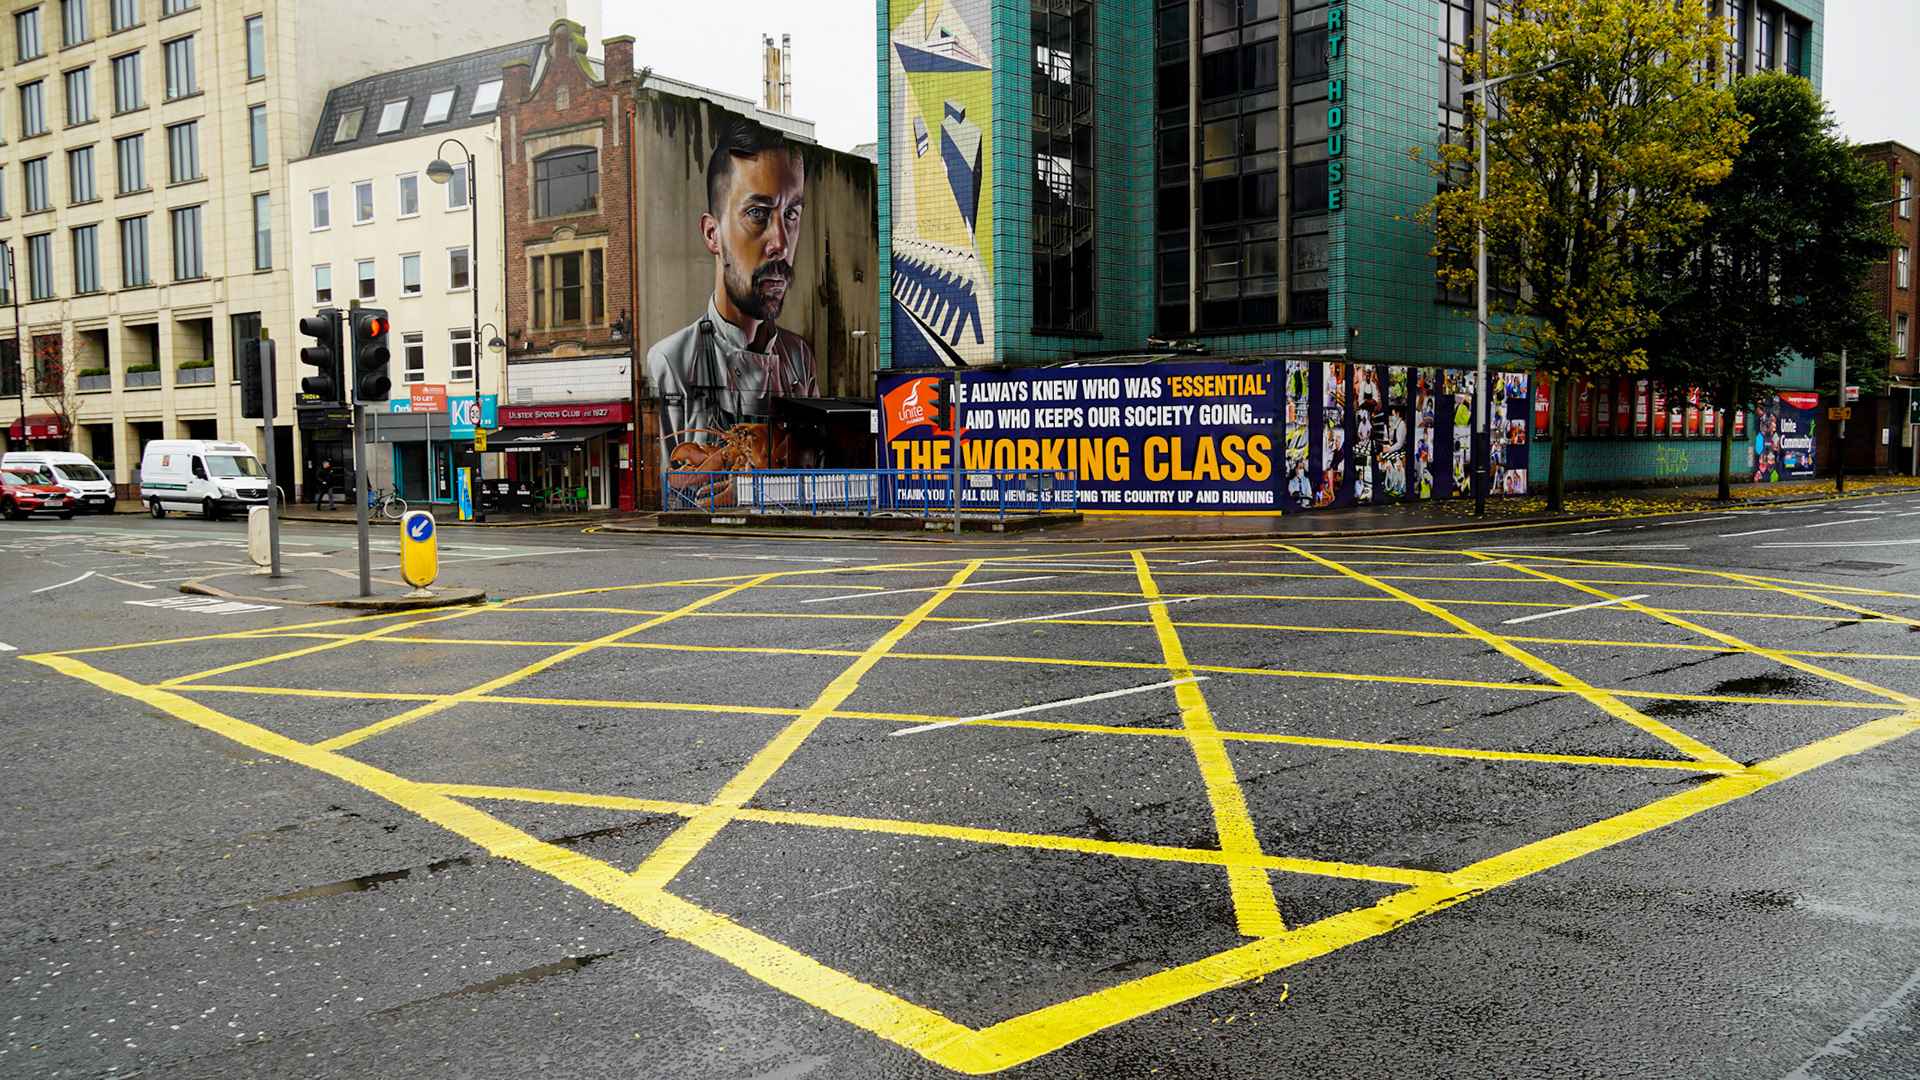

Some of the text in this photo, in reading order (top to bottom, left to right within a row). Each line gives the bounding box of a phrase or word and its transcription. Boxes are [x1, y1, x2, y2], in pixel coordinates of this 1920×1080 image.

[1328, 0, 1342, 210] RT HOUSE
[971, 381, 1028, 403] ALWAYS
[1032, 380, 1078, 401] KNEW
[1082, 378, 1120, 400] WHO
[1124, 377, 1162, 399] WAS
[1167, 374, 1271, 398] 'ESSENTIAL'
[471, 409, 479, 419] 30
[508, 411, 533, 419] ULSTER
[561, 409, 581, 418] CLUB
[592, 409, 609, 417] 1927
[965, 404, 1273, 429] AND WHO KEEPS OUR SOCIETY GOING...
[1780, 419, 1797, 433] Unite
[1780, 434, 1813, 453] Community
[891, 435, 1272, 482] THE WORKING CLASS
[897, 489, 925, 501] THANK
[927, 489, 945, 501] YOU
[963, 489, 978, 501] ALL
[980, 489, 999, 501] OUR
[1055, 489, 1098, 502] KEEPING
[1101, 490, 1121, 503] THE
[1124, 490, 1175, 503] COUNTRY
[1178, 490, 1193, 503] UP
[1196, 490, 1220, 503] AND
[1223, 490, 1274, 504] RUNNING
